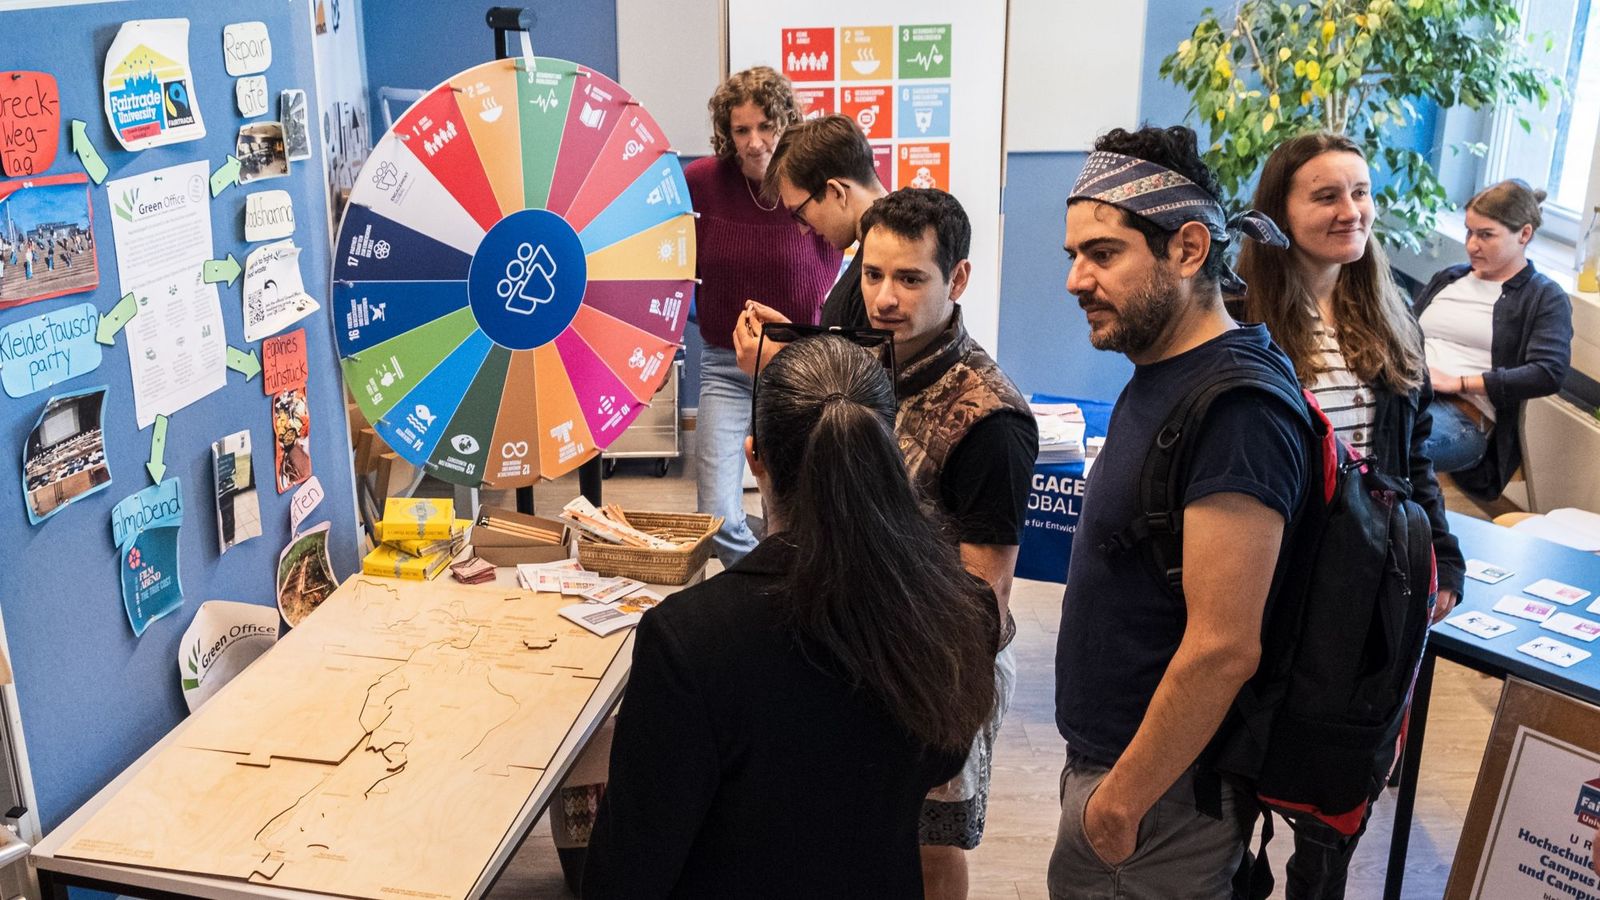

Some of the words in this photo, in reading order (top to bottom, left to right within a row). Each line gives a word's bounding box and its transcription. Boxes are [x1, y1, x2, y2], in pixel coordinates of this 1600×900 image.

[786, 31, 792, 45] 1
[844, 30, 851, 44] 2
[902, 28, 910, 42] 3
[225, 32, 267, 70] Repair
[467, 85, 474, 99] 2
[111, 90, 161, 113] Fairtrade
[118, 107, 157, 124] University
[2, 120, 47, 153] Weg-
[5, 149, 33, 175] Tag
[138, 201, 163, 215] Green
[163, 193, 186, 208] Office
[347, 255, 359, 267] 17
[348, 329, 360, 341] 16
[29, 346, 71, 391] party
[412, 438, 424, 452] 14
[465, 463, 476, 475] 13
[522, 463, 530, 475] 12
[1031, 518, 1044, 528] für
[140, 565, 154, 581] FILM
[140, 571, 161, 591] ABEND
[201, 634, 227, 669] Green
[229, 623, 276, 638] Office
[1540, 854, 1595, 887] Campus
[1518, 863, 1546, 881] und
[1546, 874, 1600, 900] Campu
